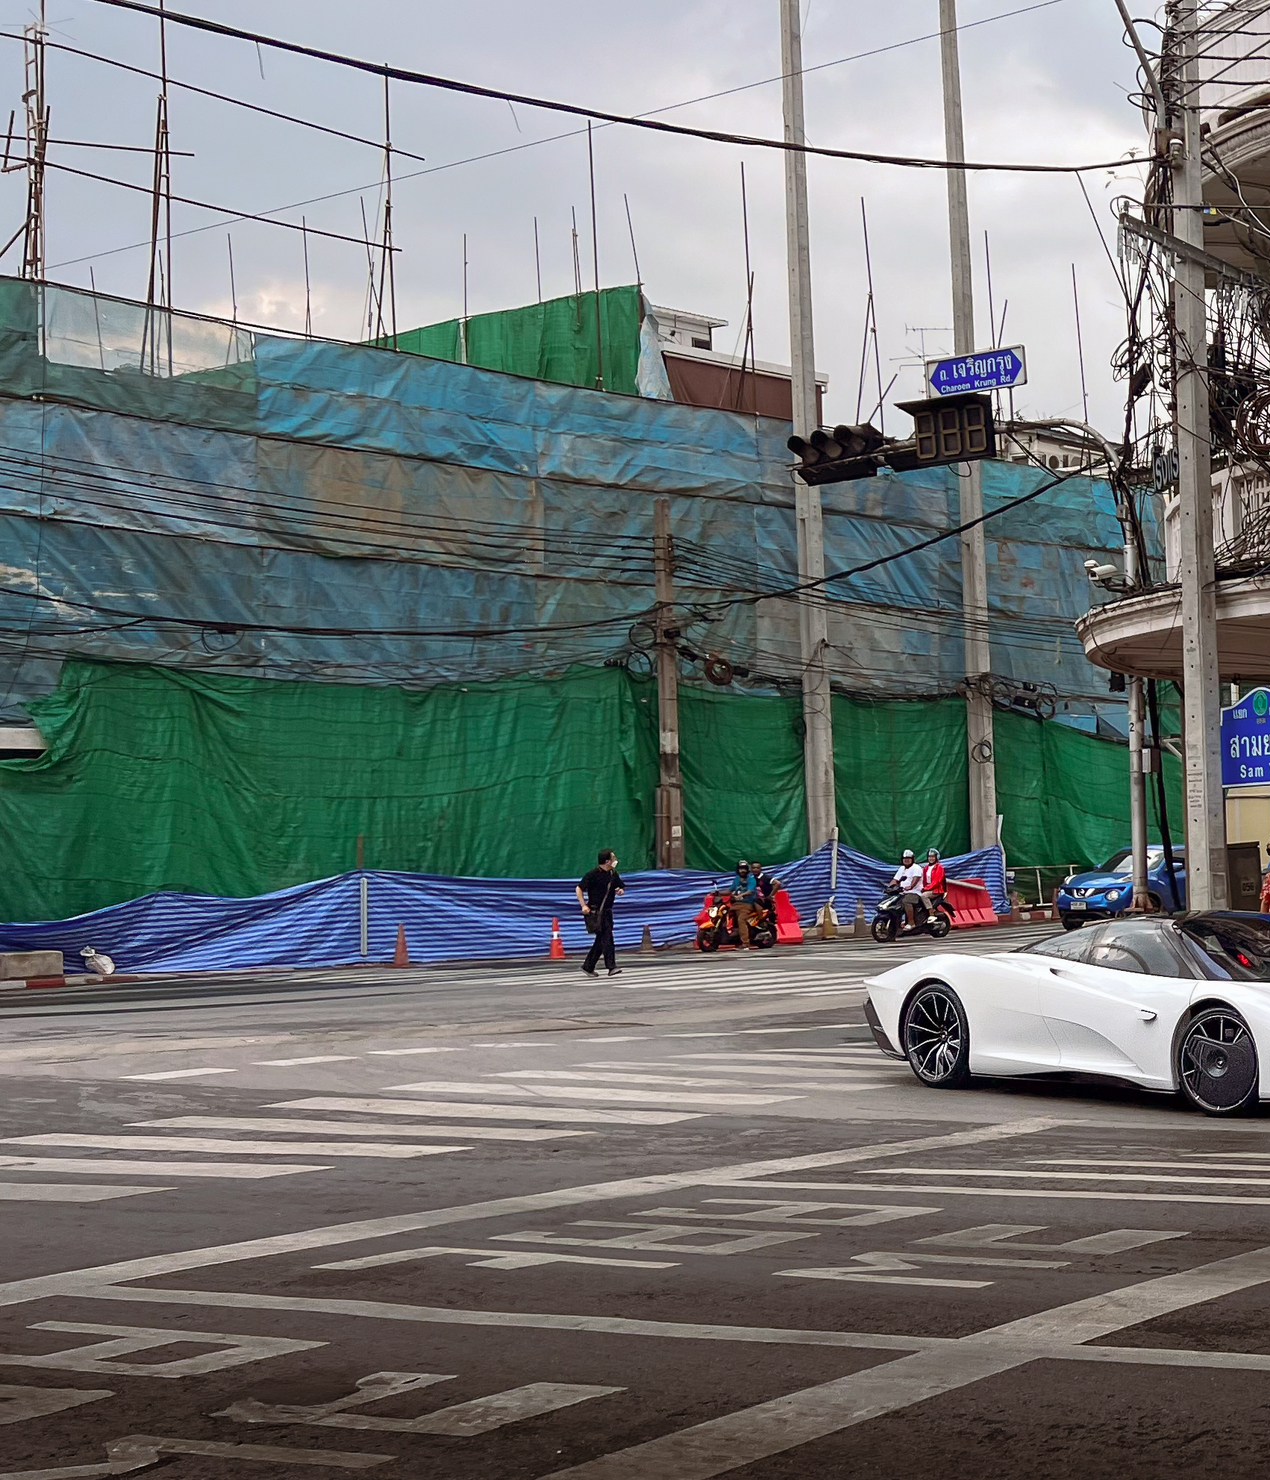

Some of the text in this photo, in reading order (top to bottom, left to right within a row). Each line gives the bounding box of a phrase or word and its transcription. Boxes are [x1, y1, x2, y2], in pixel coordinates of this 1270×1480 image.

[952, 355, 1012, 379] เจริญกรุง
[941, 374, 1013, 393] Charoen Krung Rd.
[1232, 708, 1248, 719] แยก
[1240, 764, 1264, 778] Sam
